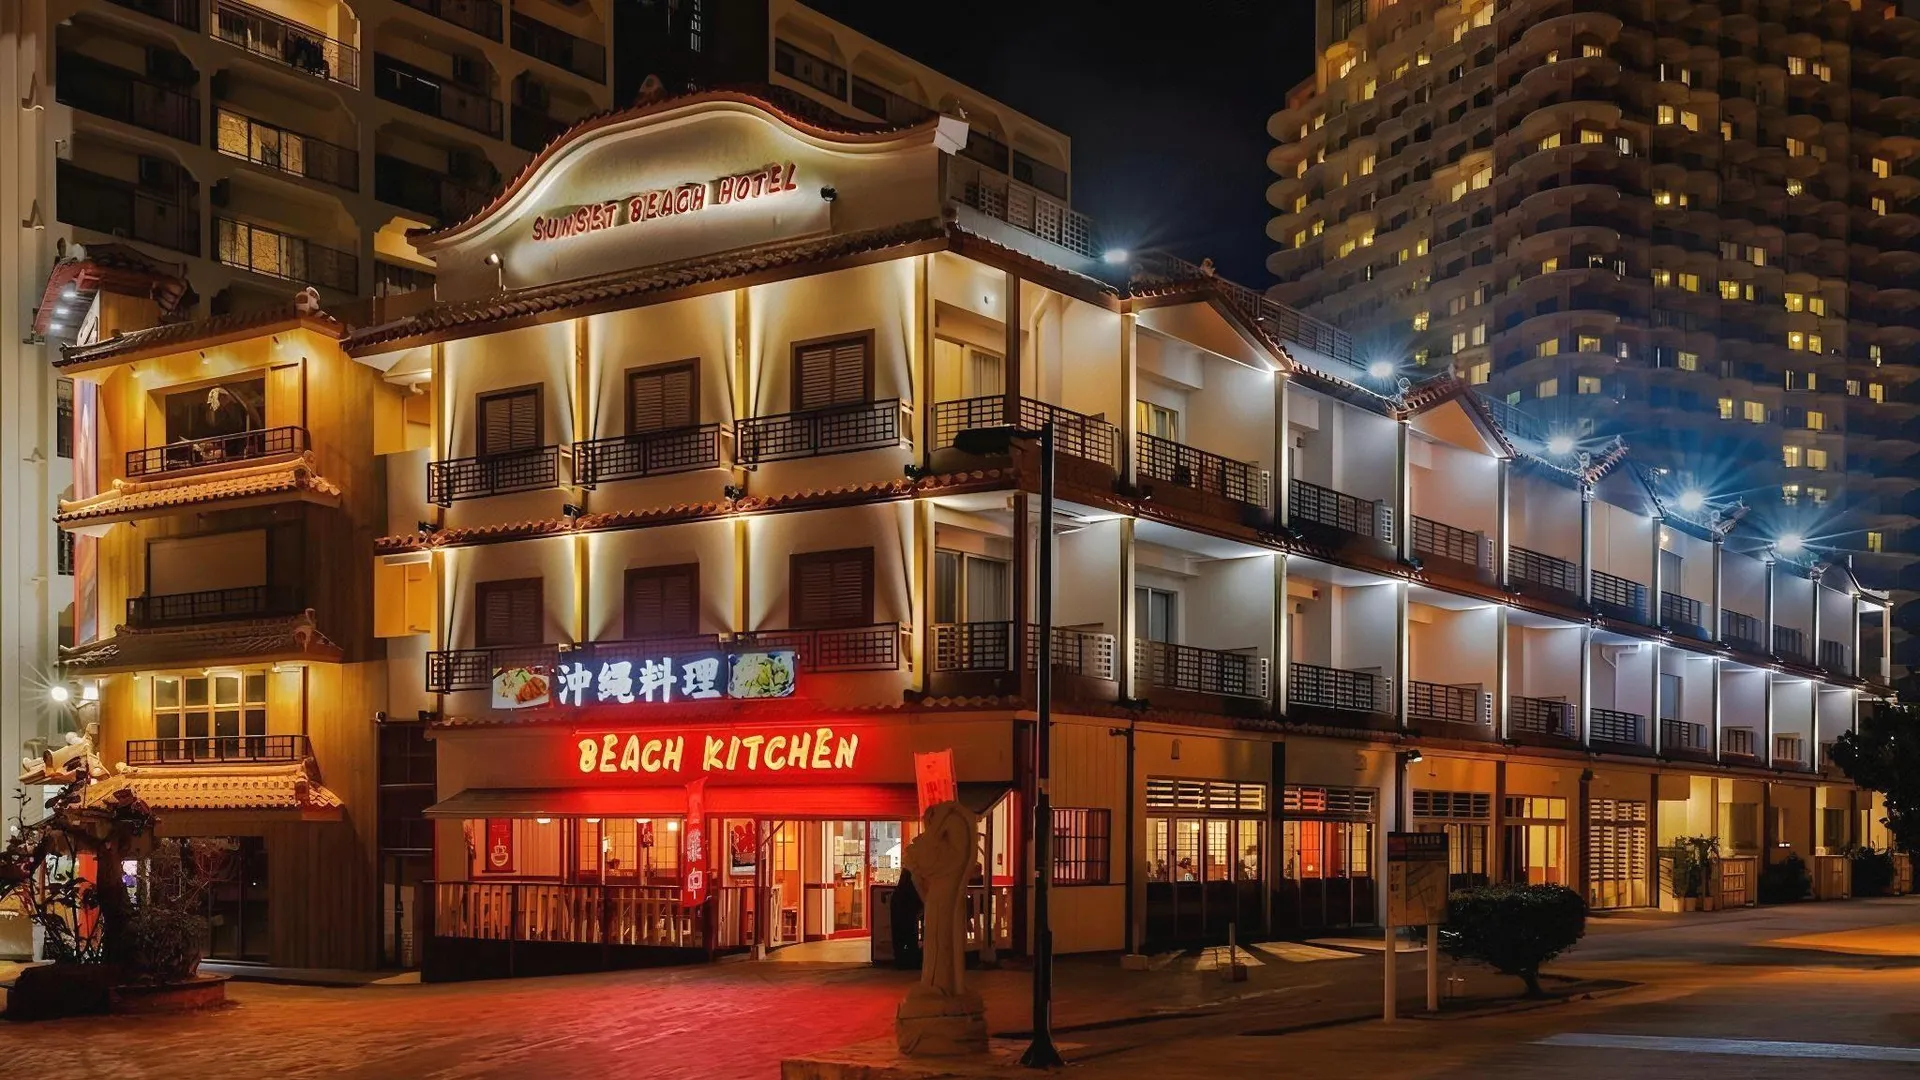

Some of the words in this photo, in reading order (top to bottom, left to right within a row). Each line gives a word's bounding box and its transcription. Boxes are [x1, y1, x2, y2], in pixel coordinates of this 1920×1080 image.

[532, 205, 617, 241] SUNSET
[630, 183, 706, 223] BEACH
[719, 161, 798, 204] HOTEL
[578, 733, 684, 773] BEACH
[702, 727, 859, 771] KITCHEN
